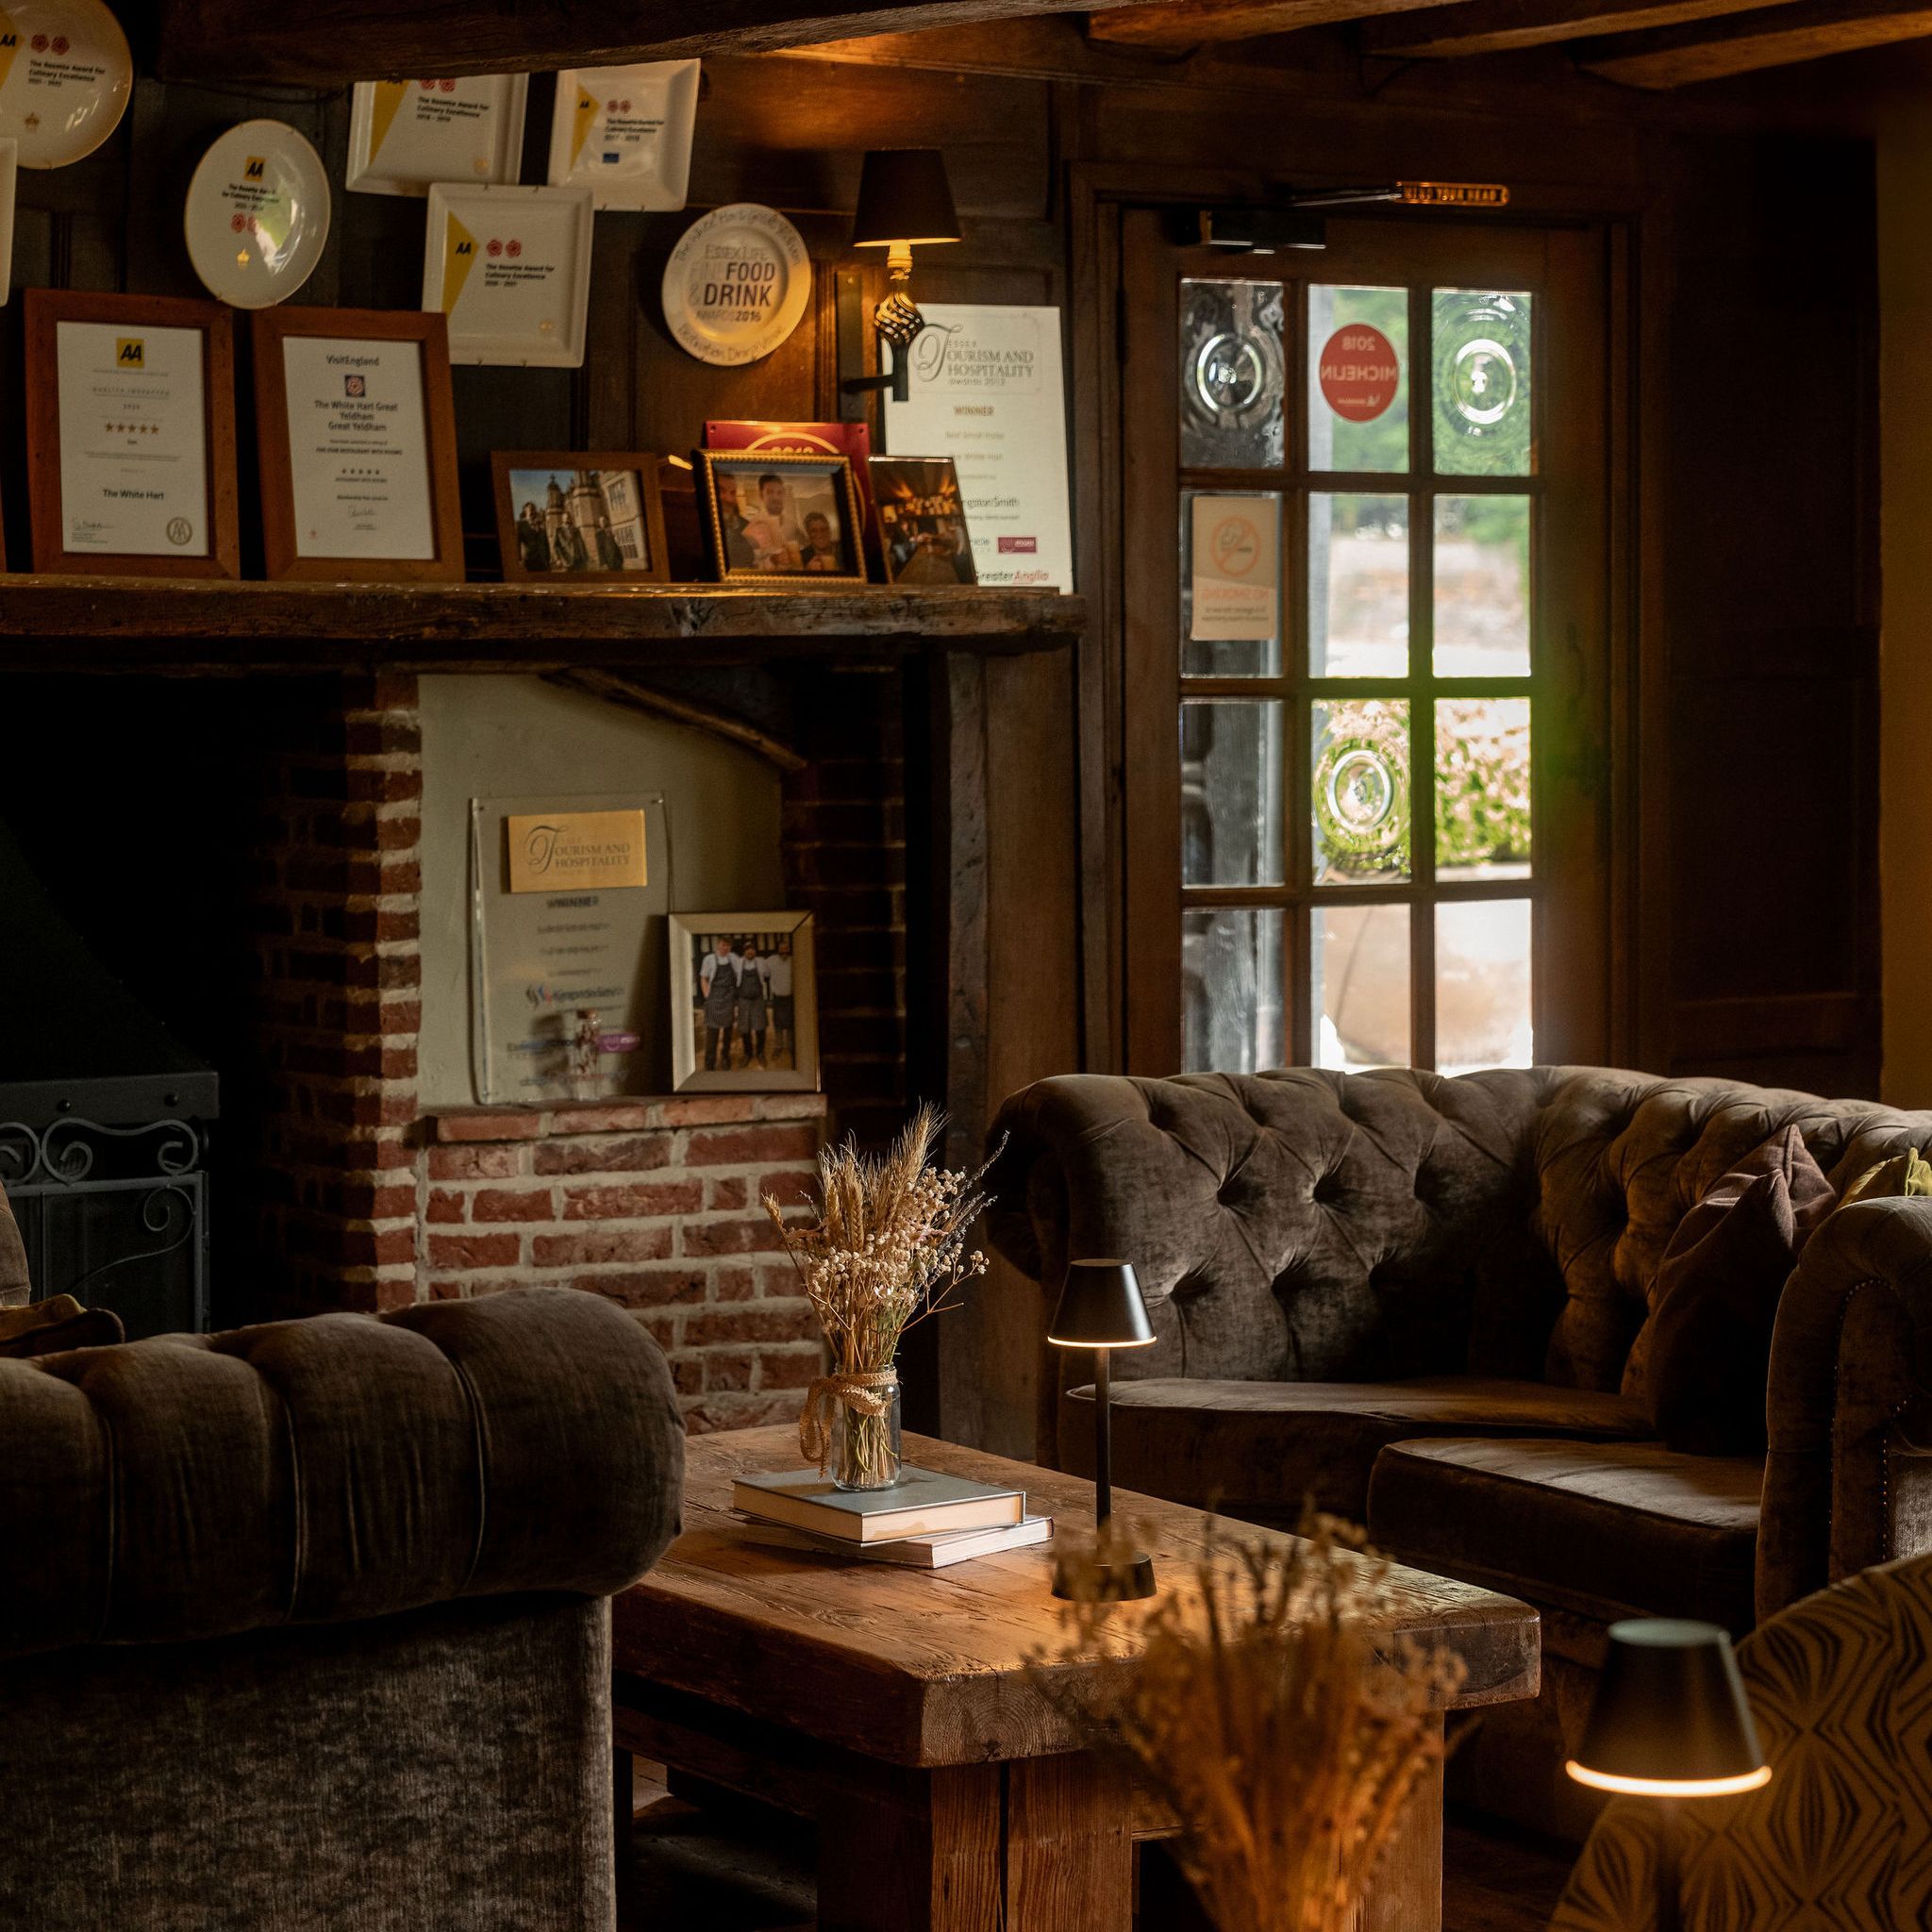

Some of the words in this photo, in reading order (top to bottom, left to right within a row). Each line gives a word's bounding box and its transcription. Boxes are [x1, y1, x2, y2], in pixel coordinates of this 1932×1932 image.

[0, 34, 16, 47] AA
[247, 162, 264, 177] AA
[455, 242, 472, 255] AA
[726, 262, 775, 282] FOOD
[705, 284, 773, 307] DRINK
[120, 344, 142, 361] AA
[1005, 350, 1034, 363] AND
[326, 355, 380, 368] VisitEngland
[947, 363, 1035, 377] HOSPITALITY
[314, 400, 329, 408] The
[331, 401, 355, 409] White
[376, 403, 398, 412] Great
[340, 412, 375, 421] Yeldham
[328, 422, 350, 430] Great
[352, 423, 387, 431] Yeldham
[103, 490, 119, 499] The
[121, 490, 144, 499] White
[146, 491, 164, 501] Hart
[605, 843, 631, 855] AND
